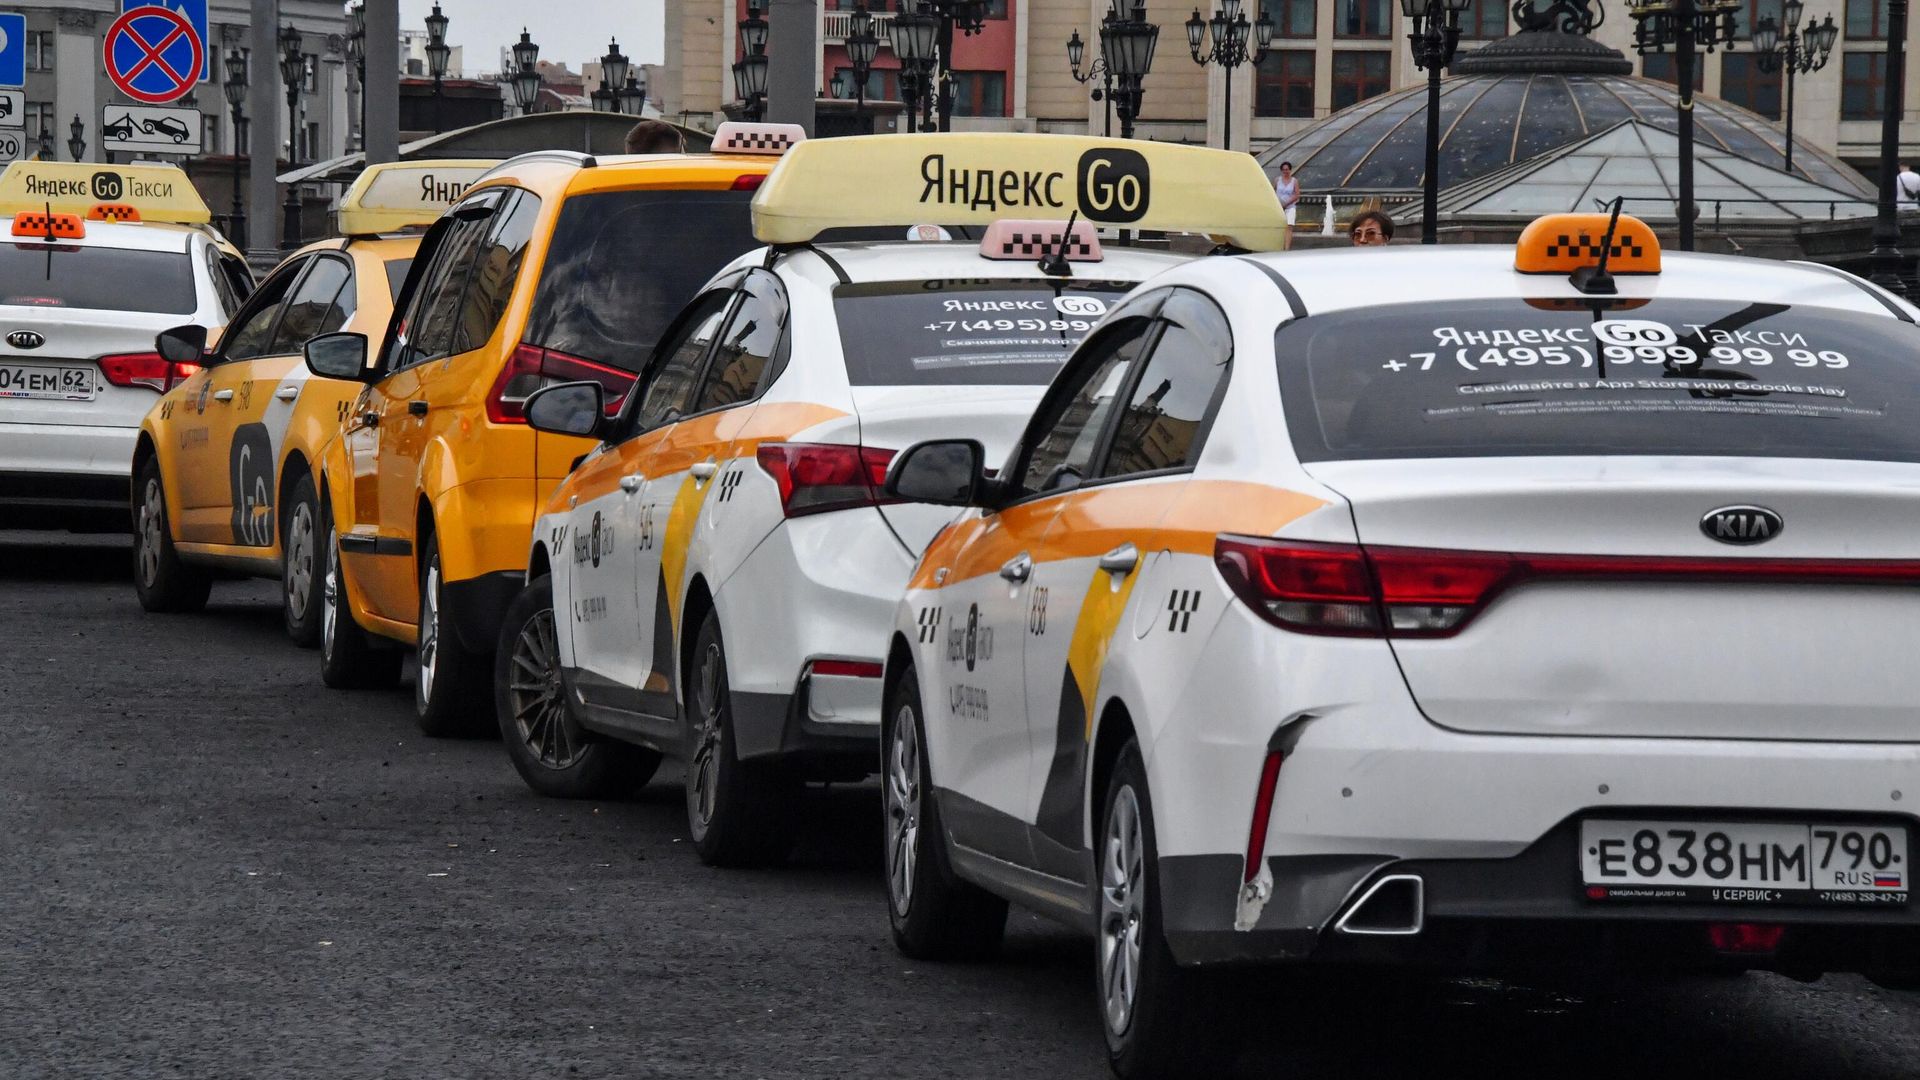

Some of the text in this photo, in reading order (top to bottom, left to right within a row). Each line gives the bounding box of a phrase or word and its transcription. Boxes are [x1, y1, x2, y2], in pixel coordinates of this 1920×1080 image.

[26, 175, 173, 198] Яндекс Go Такси
[919, 154, 1141, 212] Яндекс Go
[943, 298, 1099, 313] Яндекс Go
[12, 333, 39, 345] KIA
[1432, 323, 1809, 347] Яндекс Go Такси
[1382, 345, 1849, 372] +7 (495) 999 99 99
[63, 371, 85, 387] 62
[1459, 381, 1574, 394] Скачивайте
[1595, 380, 1634, 390] App
[1637, 380, 1688, 389] Store
[1735, 382, 1802, 393] Google
[1807, 385, 1846, 397] Play
[1716, 514, 1770, 537] KIA
[1814, 831, 1891, 871] 790
[1835, 872, 1872, 885] RUS
[1723, 889, 1772, 901] СЕРВИС
